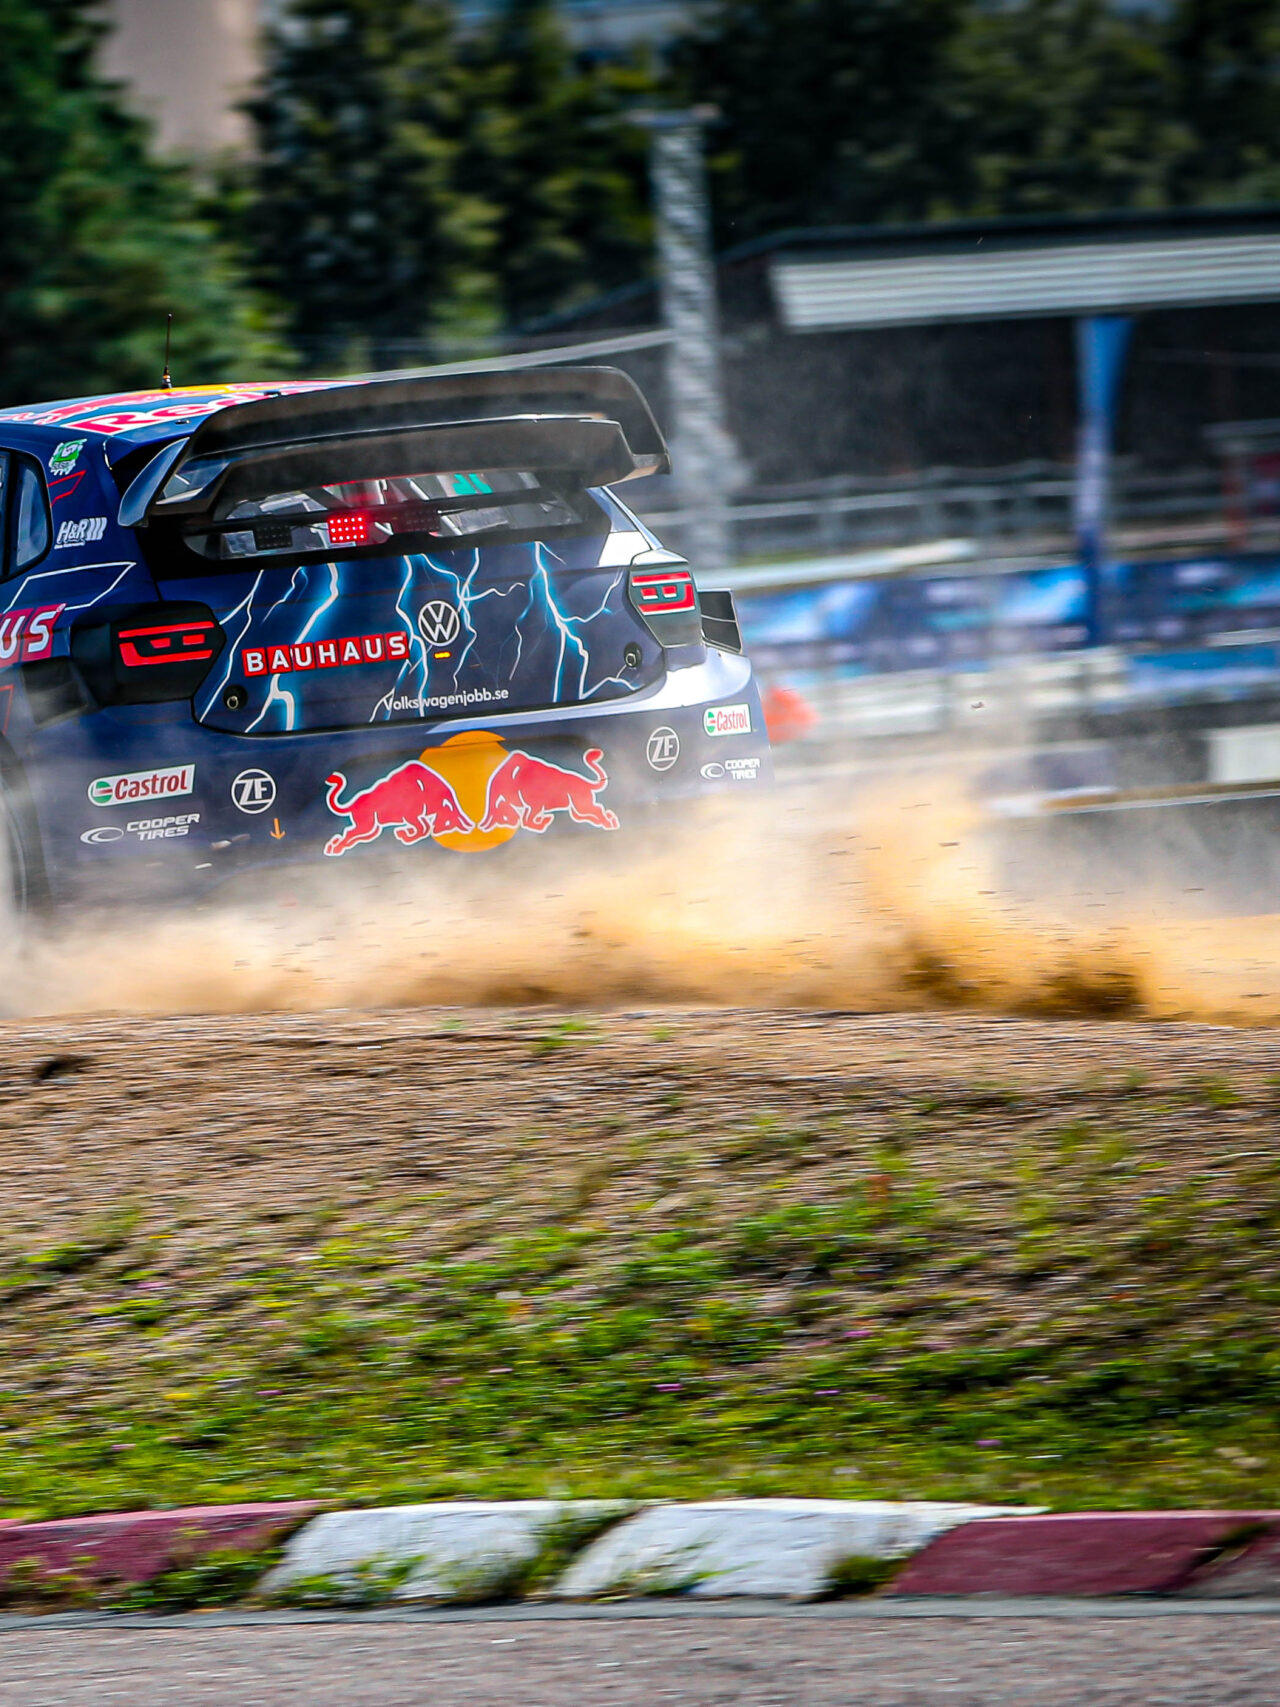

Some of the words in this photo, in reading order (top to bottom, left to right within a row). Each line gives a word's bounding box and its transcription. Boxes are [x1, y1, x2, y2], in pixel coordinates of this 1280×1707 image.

[56, 519, 89, 544] H&R
[245, 635, 407, 673] BAUHAUS
[383, 687, 509, 712] Volkswagenjobb.se
[716, 709, 748, 732] Castrol
[650, 735, 677, 763] ZF
[725, 758, 760, 770] COOPER
[731, 769, 757, 780] TIRES
[114, 769, 187, 801] Castrol
[236, 777, 271, 806] ZF
[126, 813, 201, 832] COOPER
[137, 825, 190, 841] TIRES
